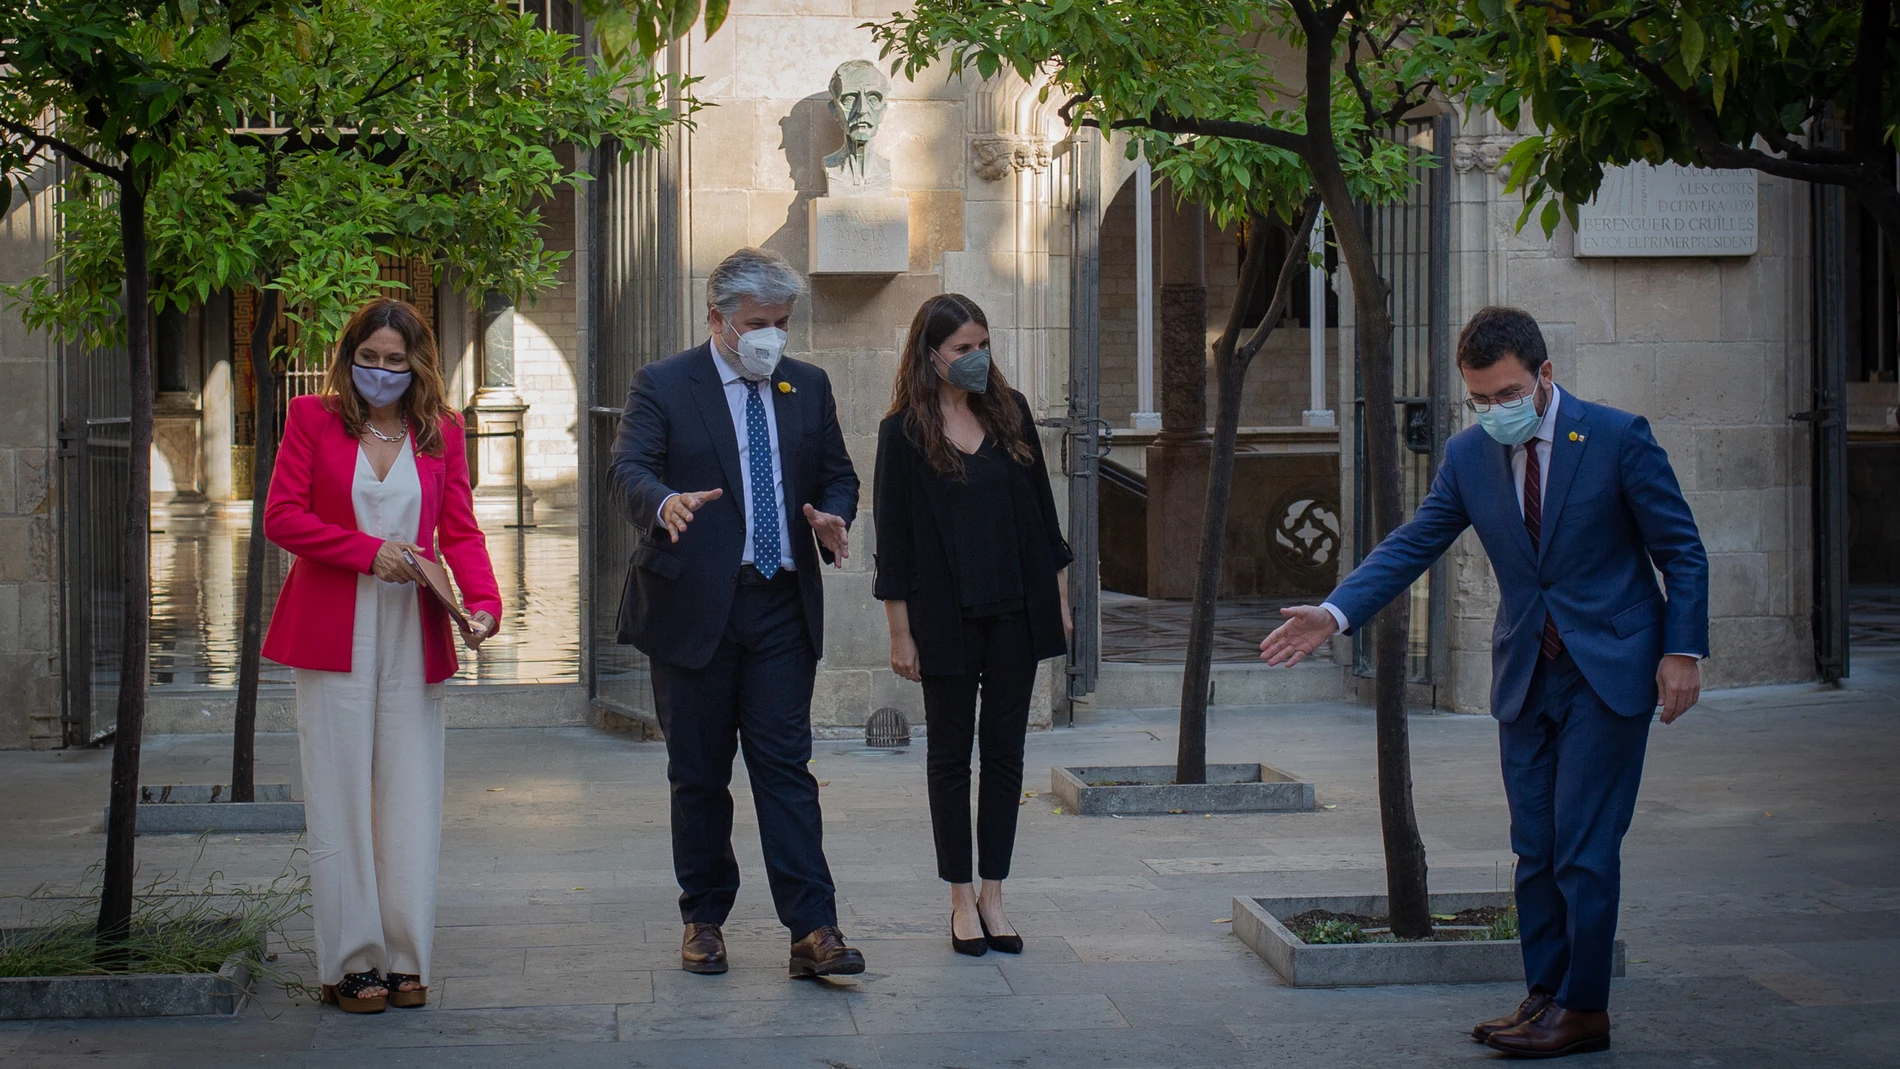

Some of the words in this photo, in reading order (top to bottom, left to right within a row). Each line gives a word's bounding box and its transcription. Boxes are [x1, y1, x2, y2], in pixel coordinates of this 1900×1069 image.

[1687, 182, 1709, 195] LES
[1711, 182, 1755, 195] CORTS
[1670, 200, 1725, 213] CERVERA
[826, 210, 899, 223] FRANCESC
[1584, 218, 1671, 232] BERENGUER
[1688, 215, 1755, 232] CRUÏLLES
[1584, 237, 1599, 249] EN
[1601, 236, 1625, 249] FOU
[1628, 236, 1644, 249] EL
[1644, 236, 1690, 249] PRIMER
[1691, 236, 1756, 249] PRESIDENT
